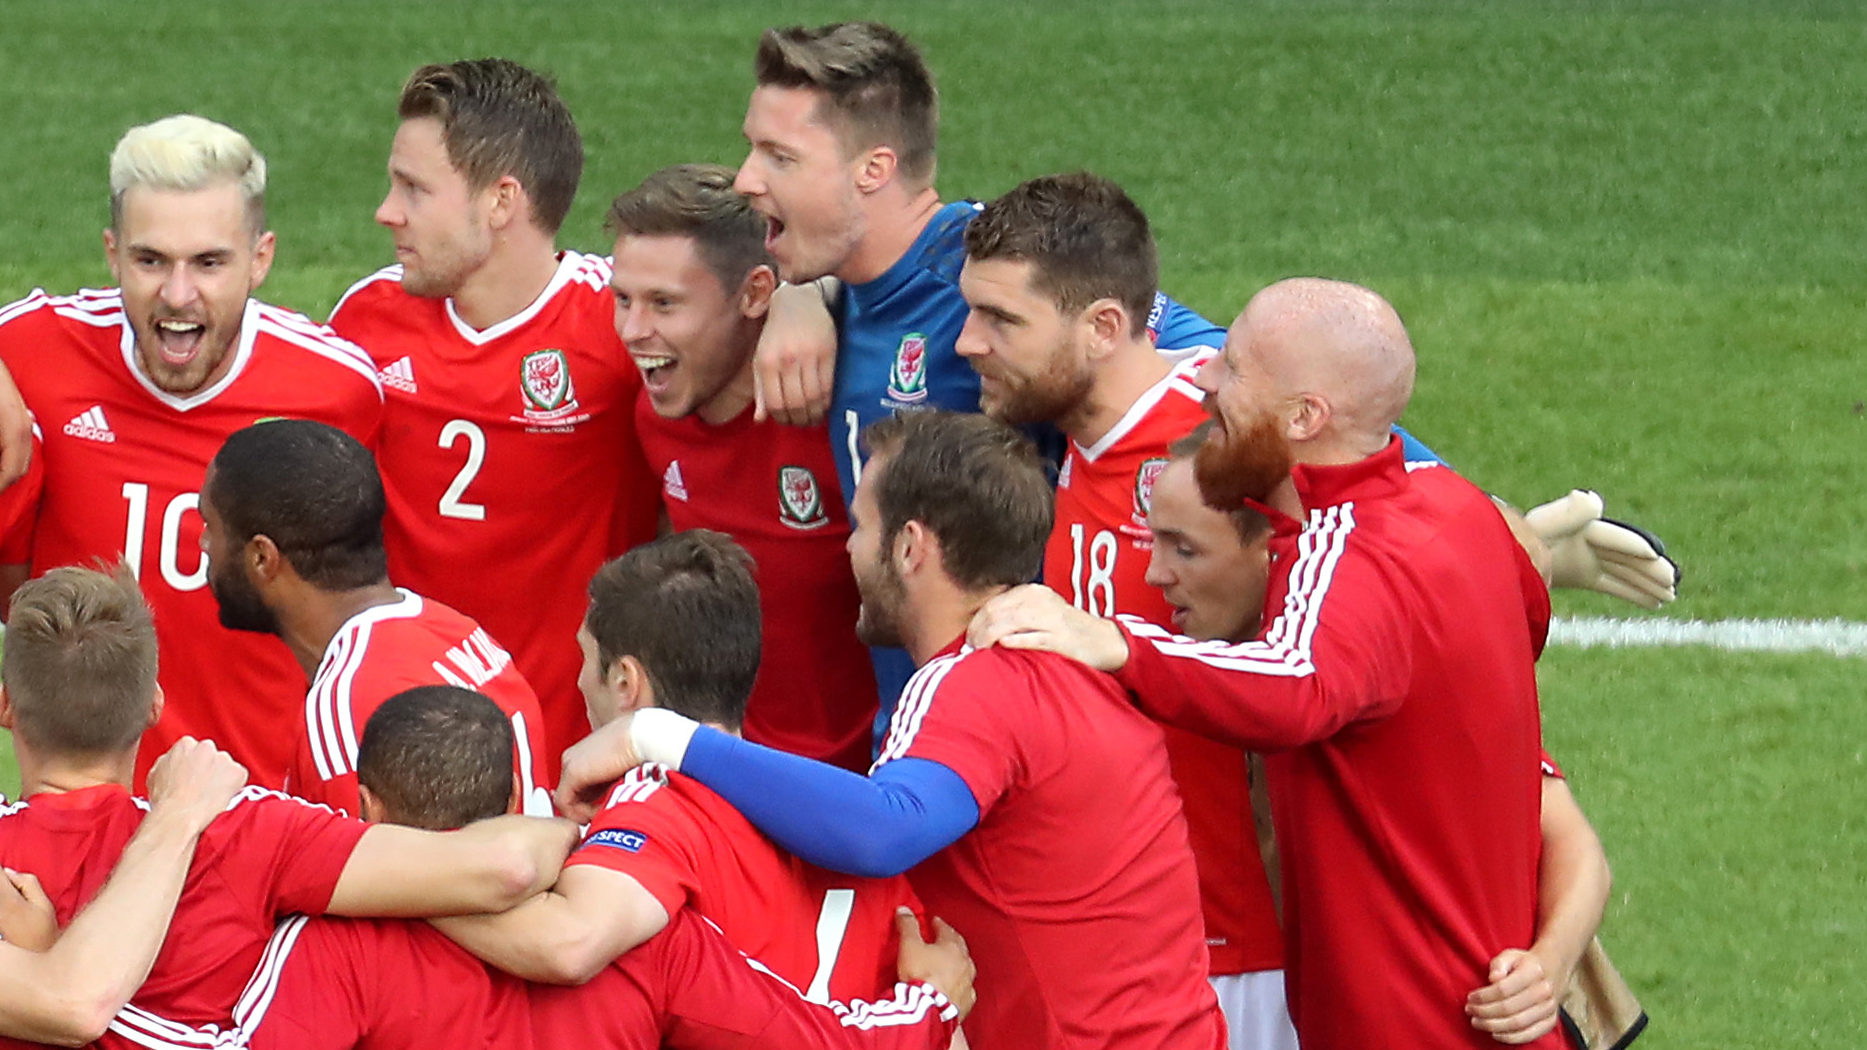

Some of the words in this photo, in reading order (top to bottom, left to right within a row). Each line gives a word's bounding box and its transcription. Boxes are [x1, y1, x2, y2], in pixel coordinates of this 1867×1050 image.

[377, 371, 418, 394] adidas
[63, 423, 116, 443] adidas
[438, 419, 487, 521] 2
[123, 481, 208, 591] 10
[1070, 523, 1119, 619] 18
